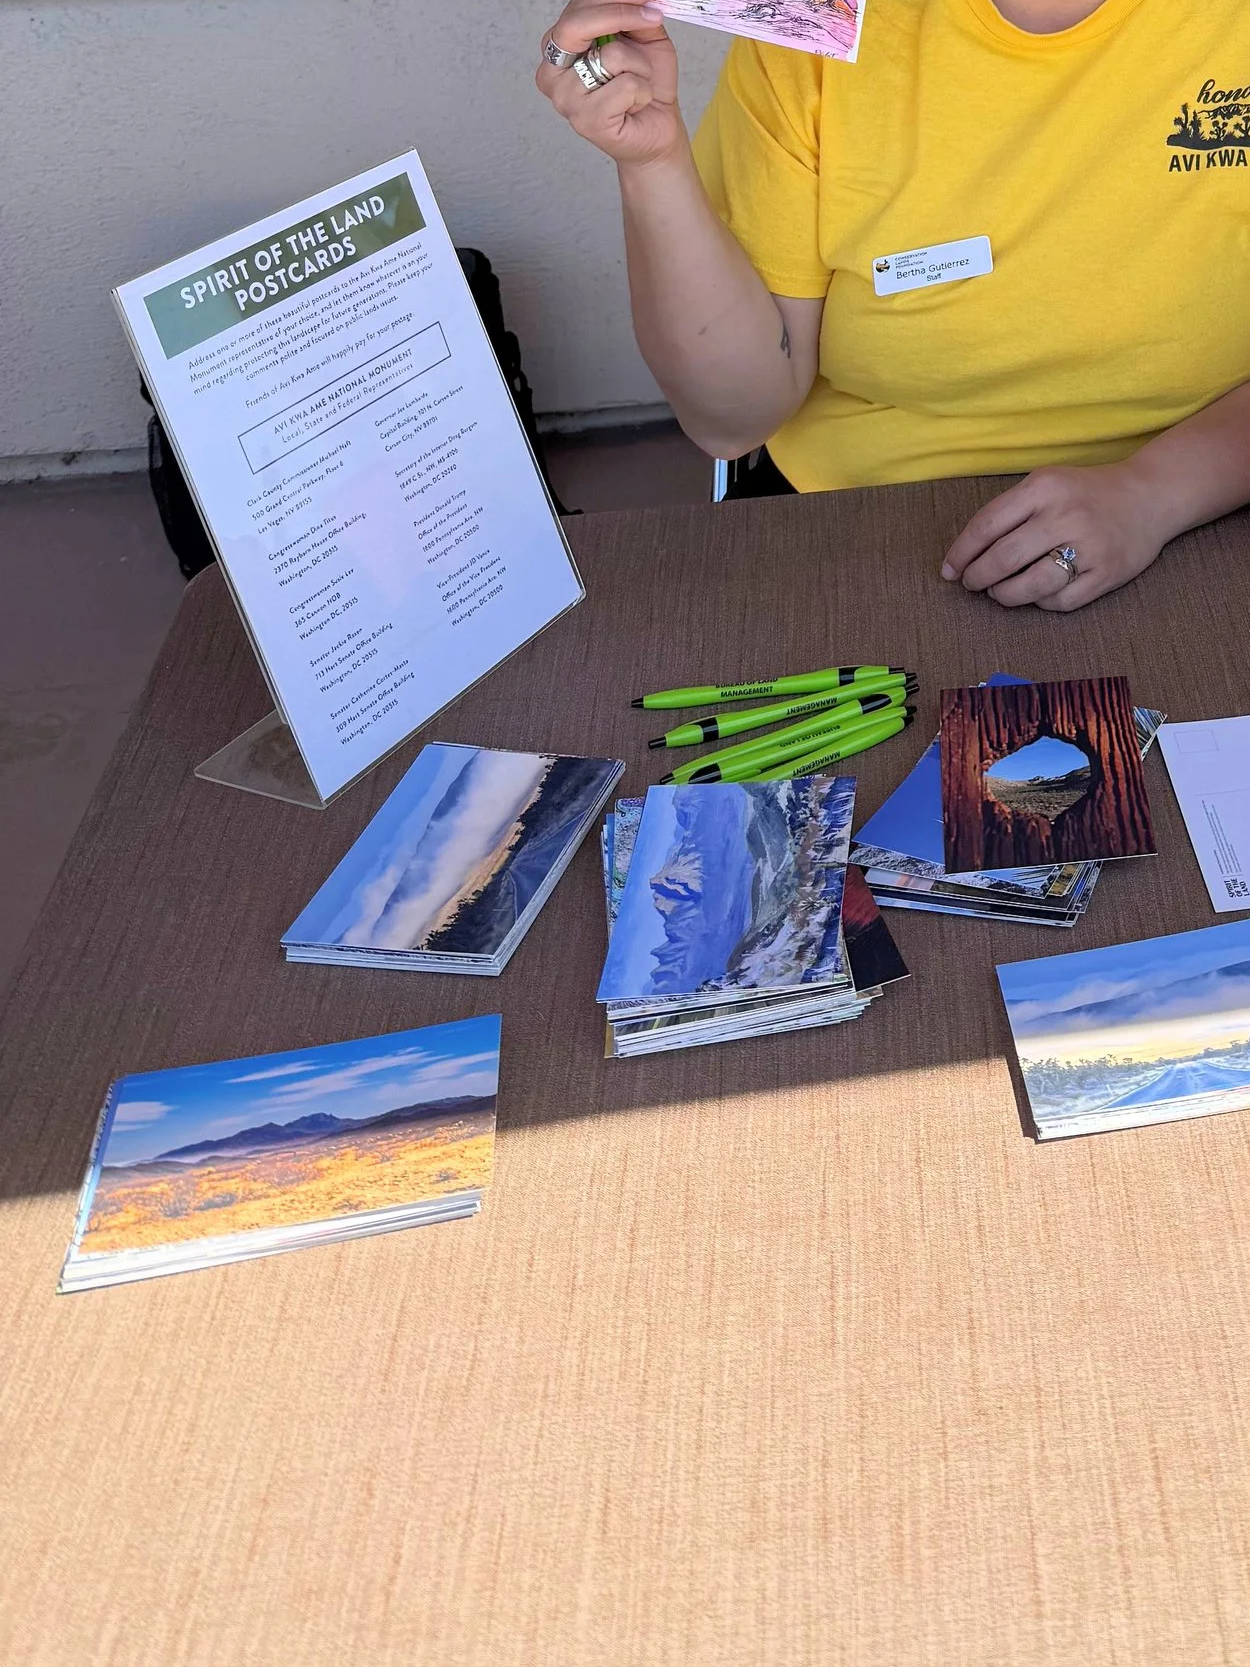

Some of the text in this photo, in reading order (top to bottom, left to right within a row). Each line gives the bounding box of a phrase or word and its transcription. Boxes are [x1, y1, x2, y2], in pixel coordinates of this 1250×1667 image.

[1169, 154, 1201, 172] AVI
[1206, 149, 1248, 168] KWA
[179, 195, 385, 309] SPIRIT OF THE LAND
[233, 235, 357, 311] POSTCARDS
[896, 267, 926, 280] Bertha
[273, 347, 413, 435] AVI KWA AME NATIONAL MONUMENT
[720, 685, 774, 698] MANAGEMENT
[786, 697, 838, 716] MANAGEMENT
[793, 750, 841, 775] MANAGEMENT
[1239, 881, 1250, 897] LAND
